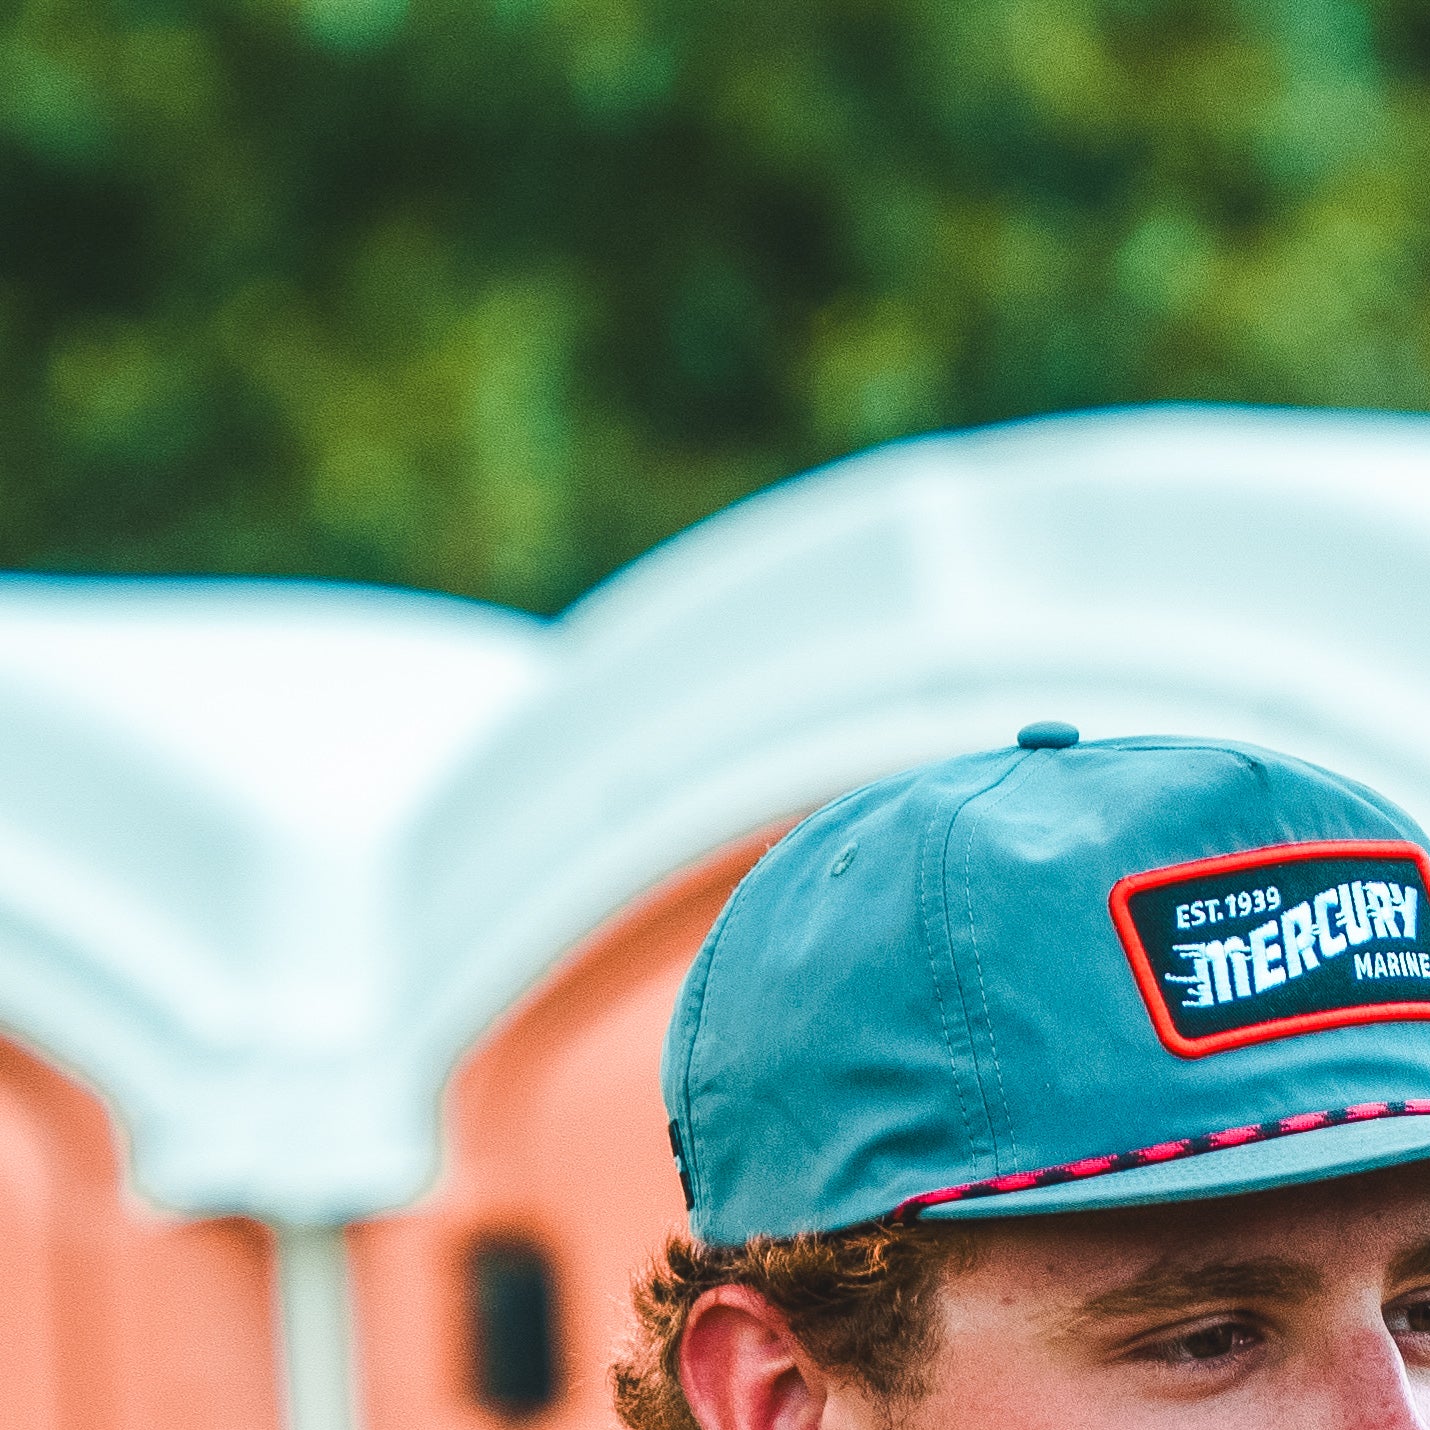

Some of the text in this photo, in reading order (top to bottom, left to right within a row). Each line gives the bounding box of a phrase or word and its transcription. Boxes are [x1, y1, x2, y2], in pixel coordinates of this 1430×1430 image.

[1166, 880, 1418, 1008] MERCURY
[1176, 886, 1281, 930] EST. 1939
